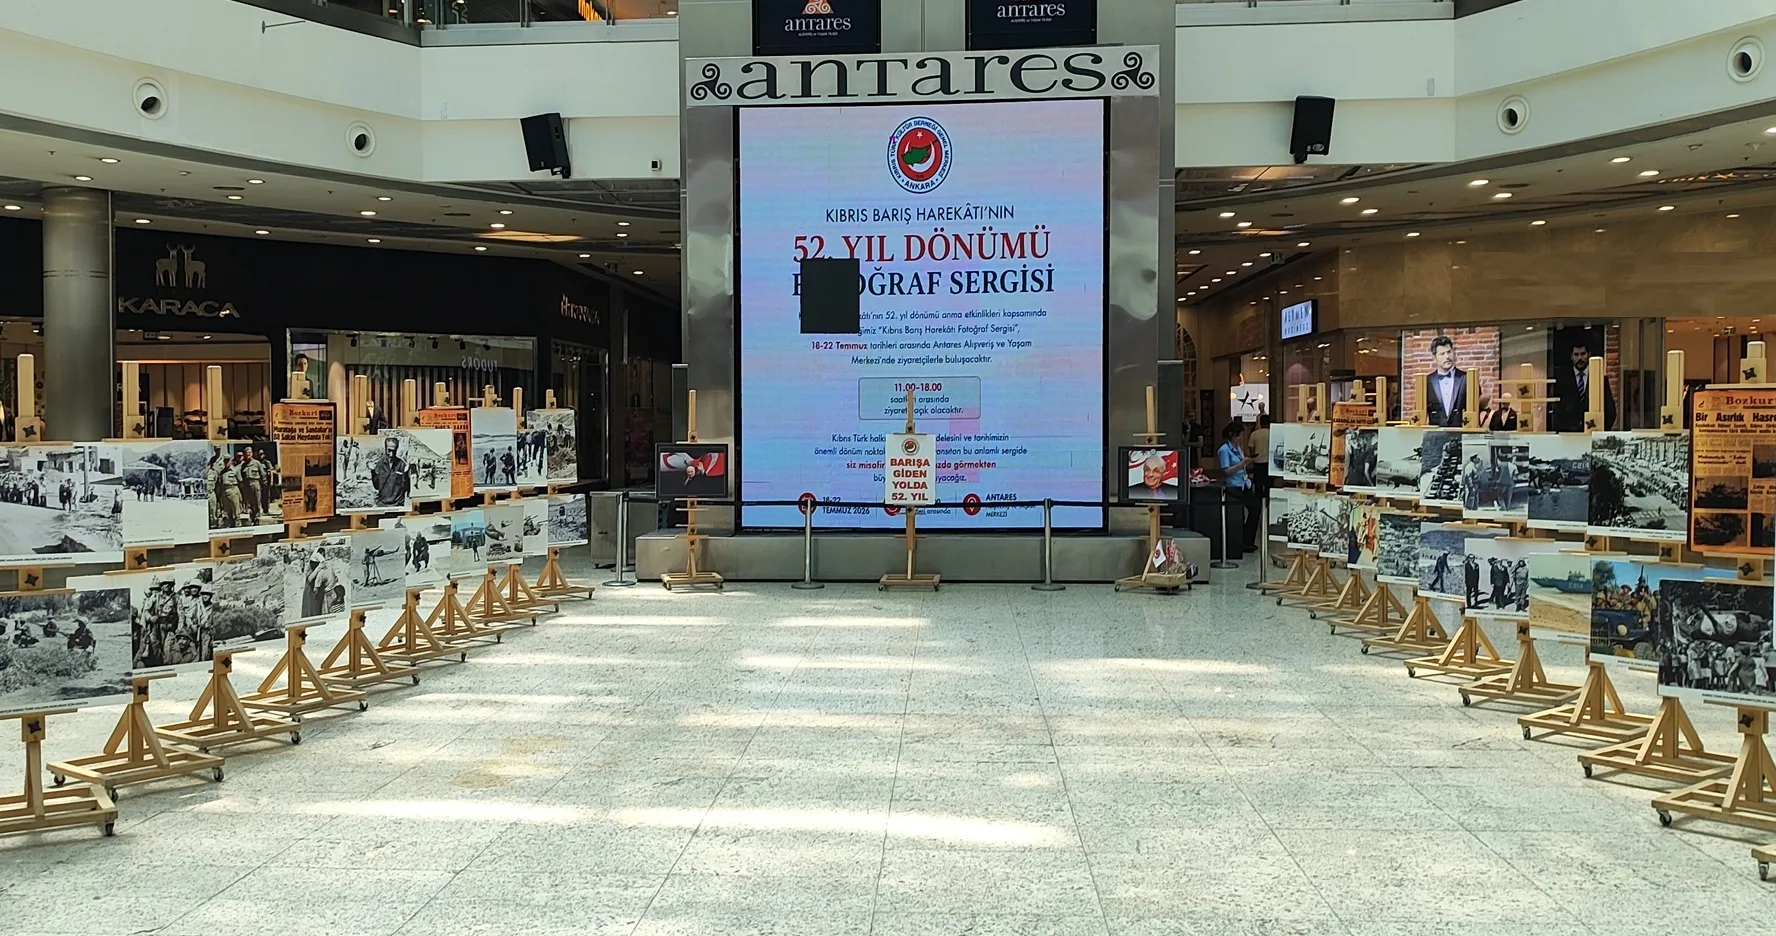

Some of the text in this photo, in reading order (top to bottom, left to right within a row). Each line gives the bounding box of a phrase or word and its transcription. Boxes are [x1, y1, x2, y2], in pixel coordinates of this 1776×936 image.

[997, 4, 1065, 17] antares
[785, 17, 851, 31] antares
[737, 53, 1106, 98] antares
[904, 180, 936, 190] ANKARA
[826, 203, 1014, 225] KIBRIS BARIŞ HAREKÂTI'NIN
[842, 235, 894, 262] YIL
[904, 224, 1051, 262] DÖNÜMÜ
[950, 264, 1055, 294] SERGİSİ
[118, 297, 240, 318] KARACA
[885, 311, 898, 320] 52.
[899, 310, 908, 322] yıl
[910, 310, 940, 319] dönümü
[964, 309, 1001, 318] etkinlikleri
[1003, 308, 1046, 320] kapsamında
[905, 326, 922, 336] Barış
[925, 325, 956, 334] Harekâtı
[958, 324, 988, 335] Fotoğraf
[812, 342, 834, 350] 18-22
[836, 342, 868, 350] Temmuz
[870, 341, 897, 350] tarihleri
[900, 340, 930, 349] arasında
[932, 340, 962, 348] Antares
[964, 340, 994, 350] Alışveriş
[1008, 339, 1032, 349] Yaşam
[851, 354, 992, 366] Merkezi'nde ziyaretçilerle buluşacaktır.
[894, 383, 942, 392] 11.00-18.00
[890, 394, 950, 404] saatli arasında
[1726, 396, 1776, 405] Bozkur
[884, 406, 964, 416] ziyaret açık olacaktır.
[1696, 412, 1776, 422] Bir Asırlık Hasre
[832, 434, 852, 442] Kıbrıs
[852, 434, 868, 442] Türk
[936, 434, 962, 442] delesini
[974, 433, 1009, 441] tarihimizin
[814, 447, 837, 455] önemli
[838, 447, 862, 455] dönüm
[963, 446, 972, 454] bu
[974, 446, 1000, 454] anlamlı
[1002, 446, 1028, 456] sergide
[890, 458, 930, 468] BARIŞA
[954, 460, 996, 470] görmekten
[893, 468, 926, 478] GİDEN
[892, 482, 928, 490] YOLDA
[892, 492, 928, 500] 52. YIL
[822, 506, 870, 514] TEMMUZ 2026
